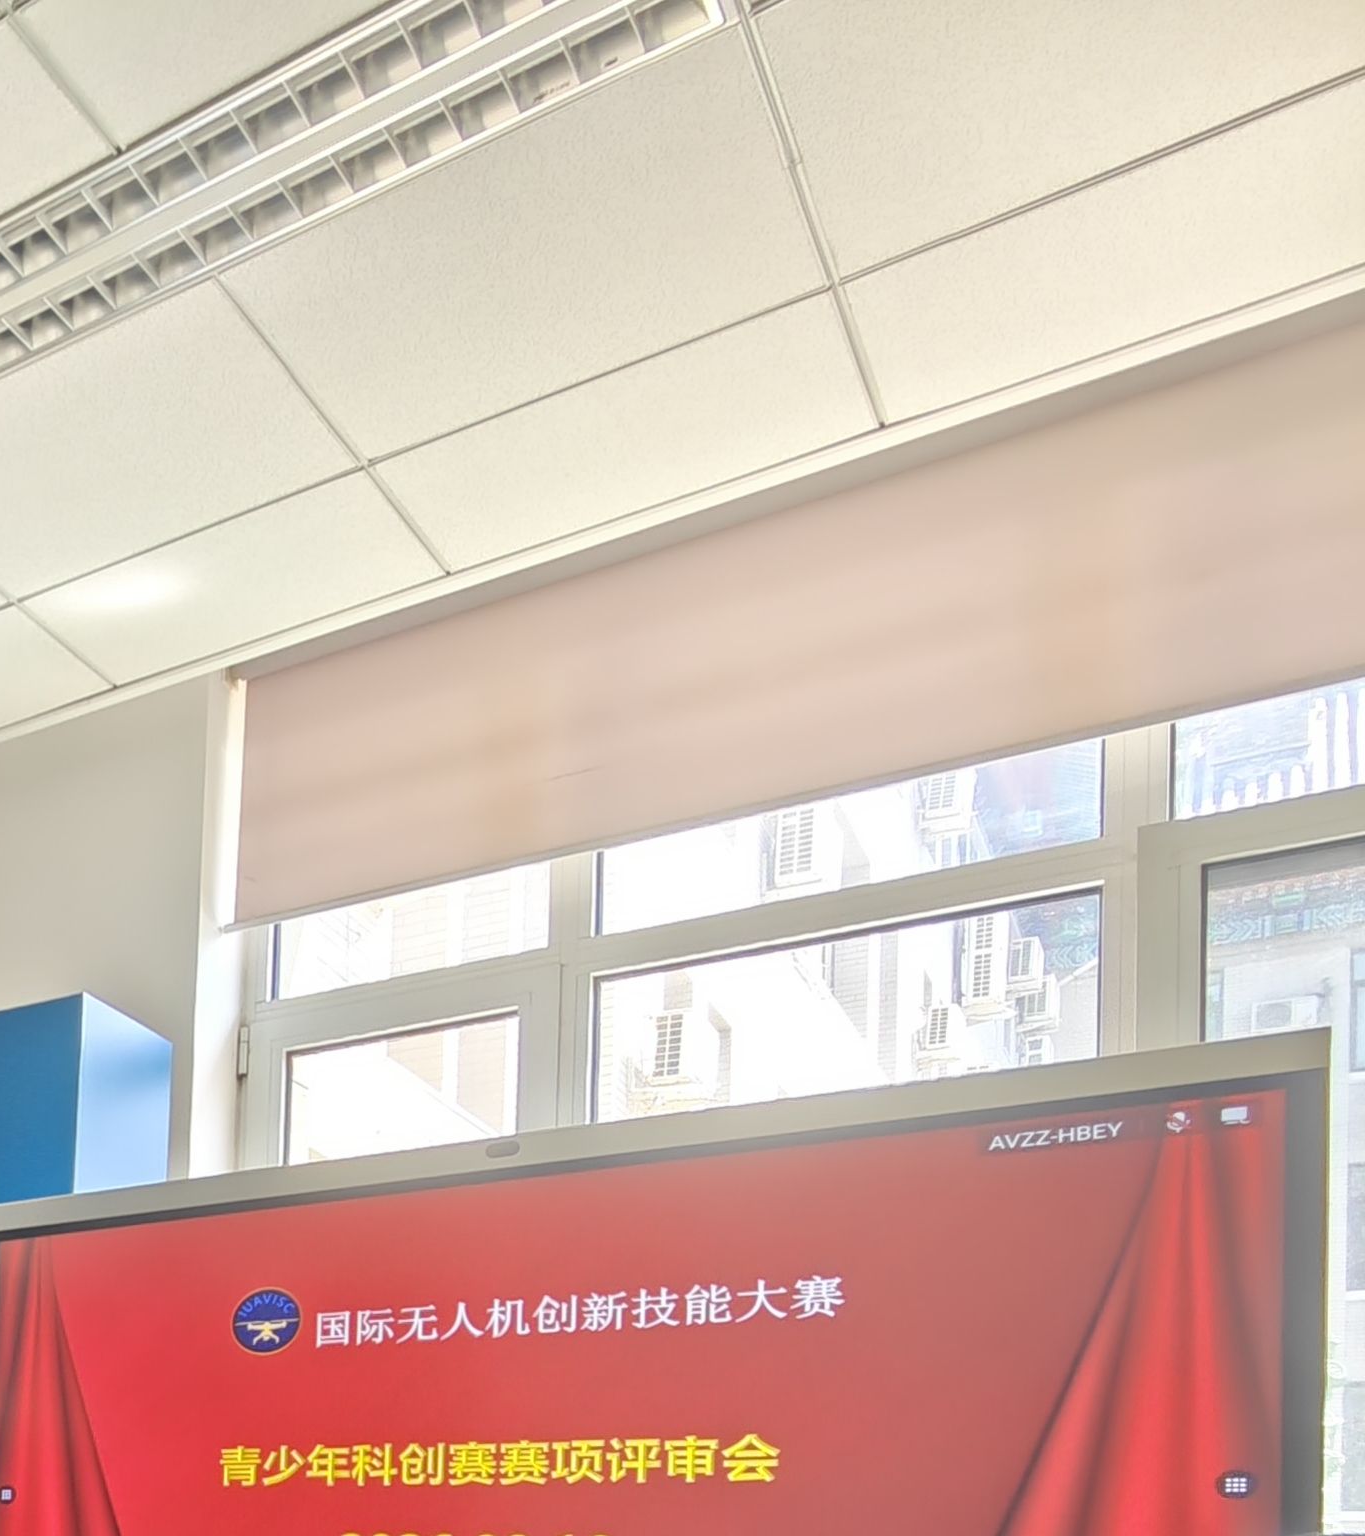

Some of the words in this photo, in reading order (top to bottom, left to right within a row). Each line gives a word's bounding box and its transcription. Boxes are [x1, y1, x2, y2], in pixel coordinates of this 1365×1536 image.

[988, 1121, 1123, 1151] AVZZ-HBEY
[315, 1275, 845, 1348] 国际无人机创新技能大赛
[220, 1433, 780, 1487] 青少年科创赛赛项评审会
